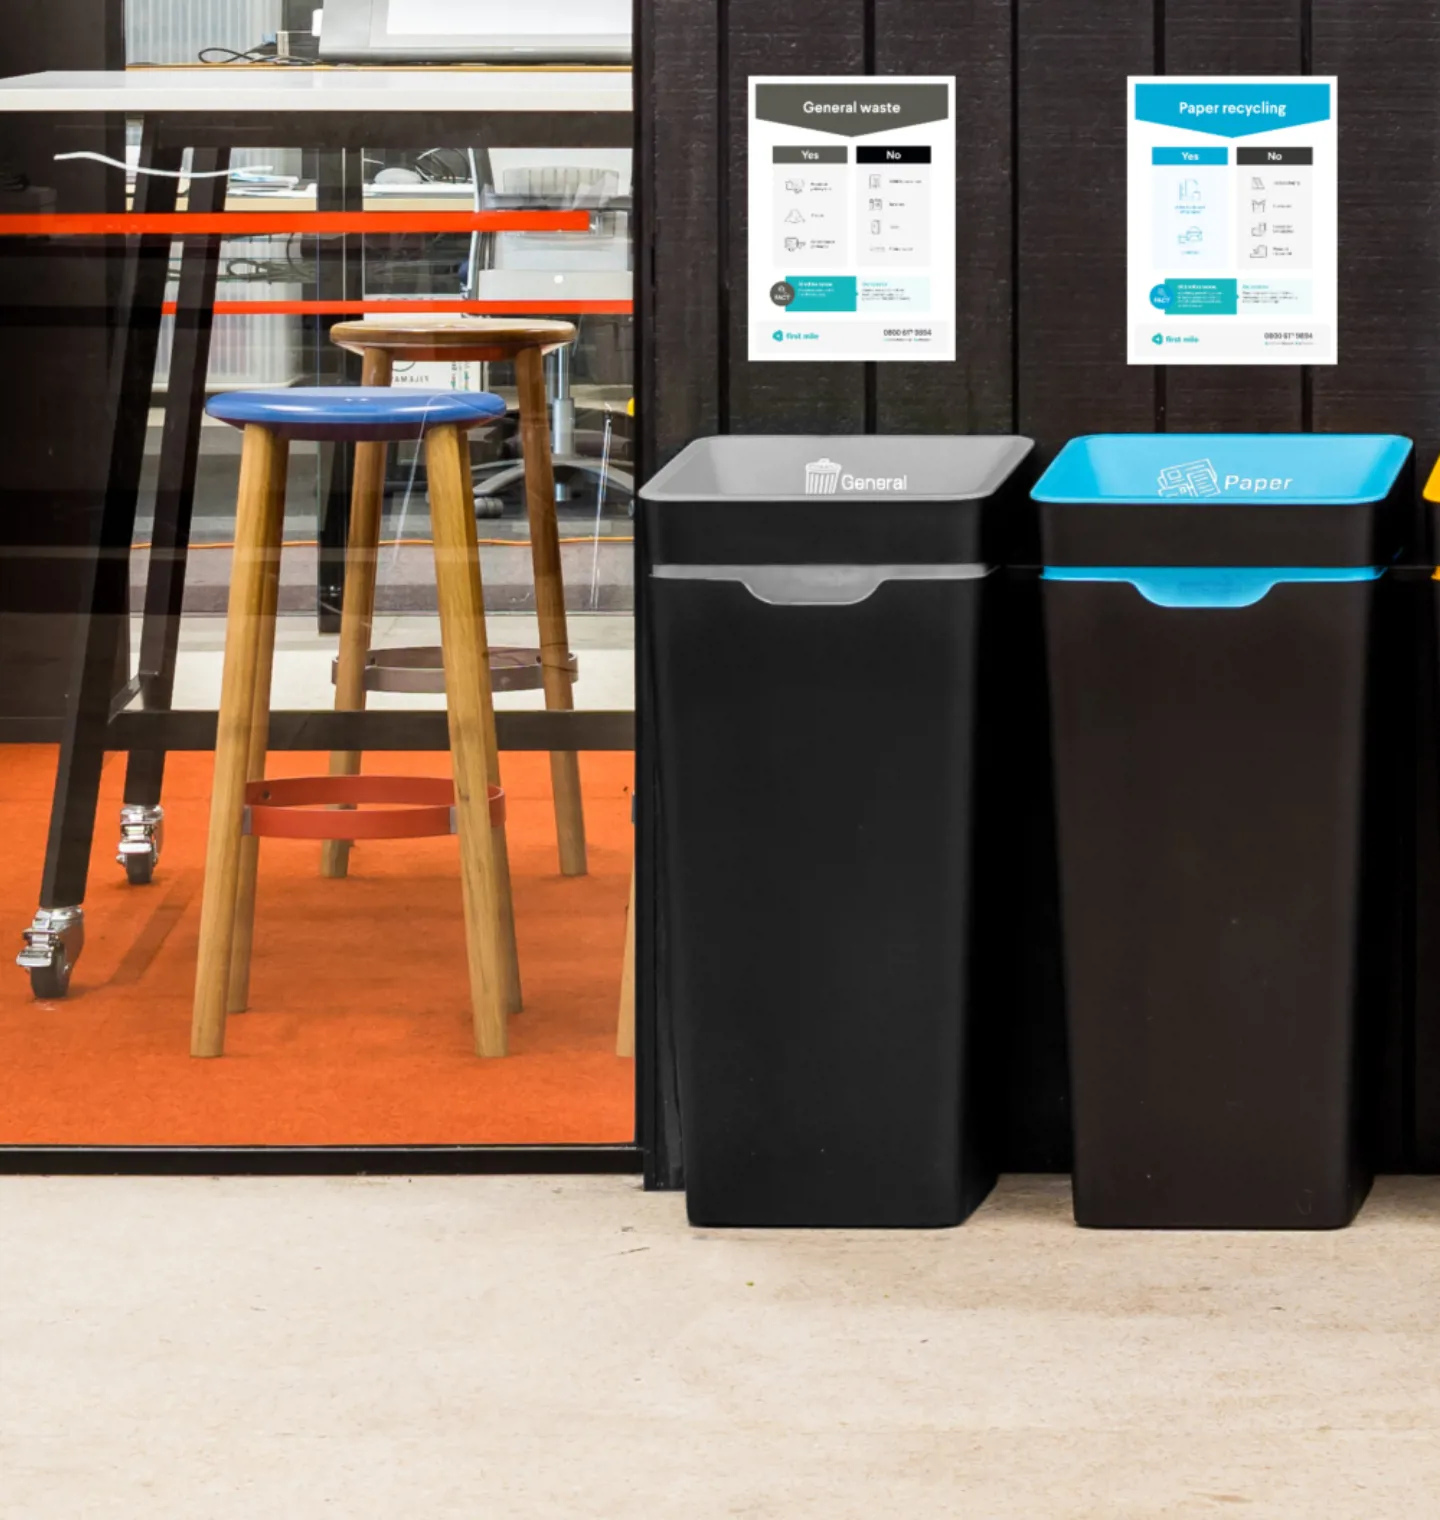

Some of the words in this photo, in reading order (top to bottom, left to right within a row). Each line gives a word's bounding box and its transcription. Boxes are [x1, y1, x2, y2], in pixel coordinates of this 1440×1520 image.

[802, 101, 857, 114] General
[860, 103, 901, 114] waste
[1179, 102, 1219, 118] Paper
[1222, 101, 1287, 118] recycling
[801, 150, 820, 160] Yes
[886, 150, 902, 160] No
[1181, 151, 1200, 161] Yes
[1267, 151, 1283, 161] No
[841, 474, 907, 491] General
[1224, 475, 1293, 493] Paper
